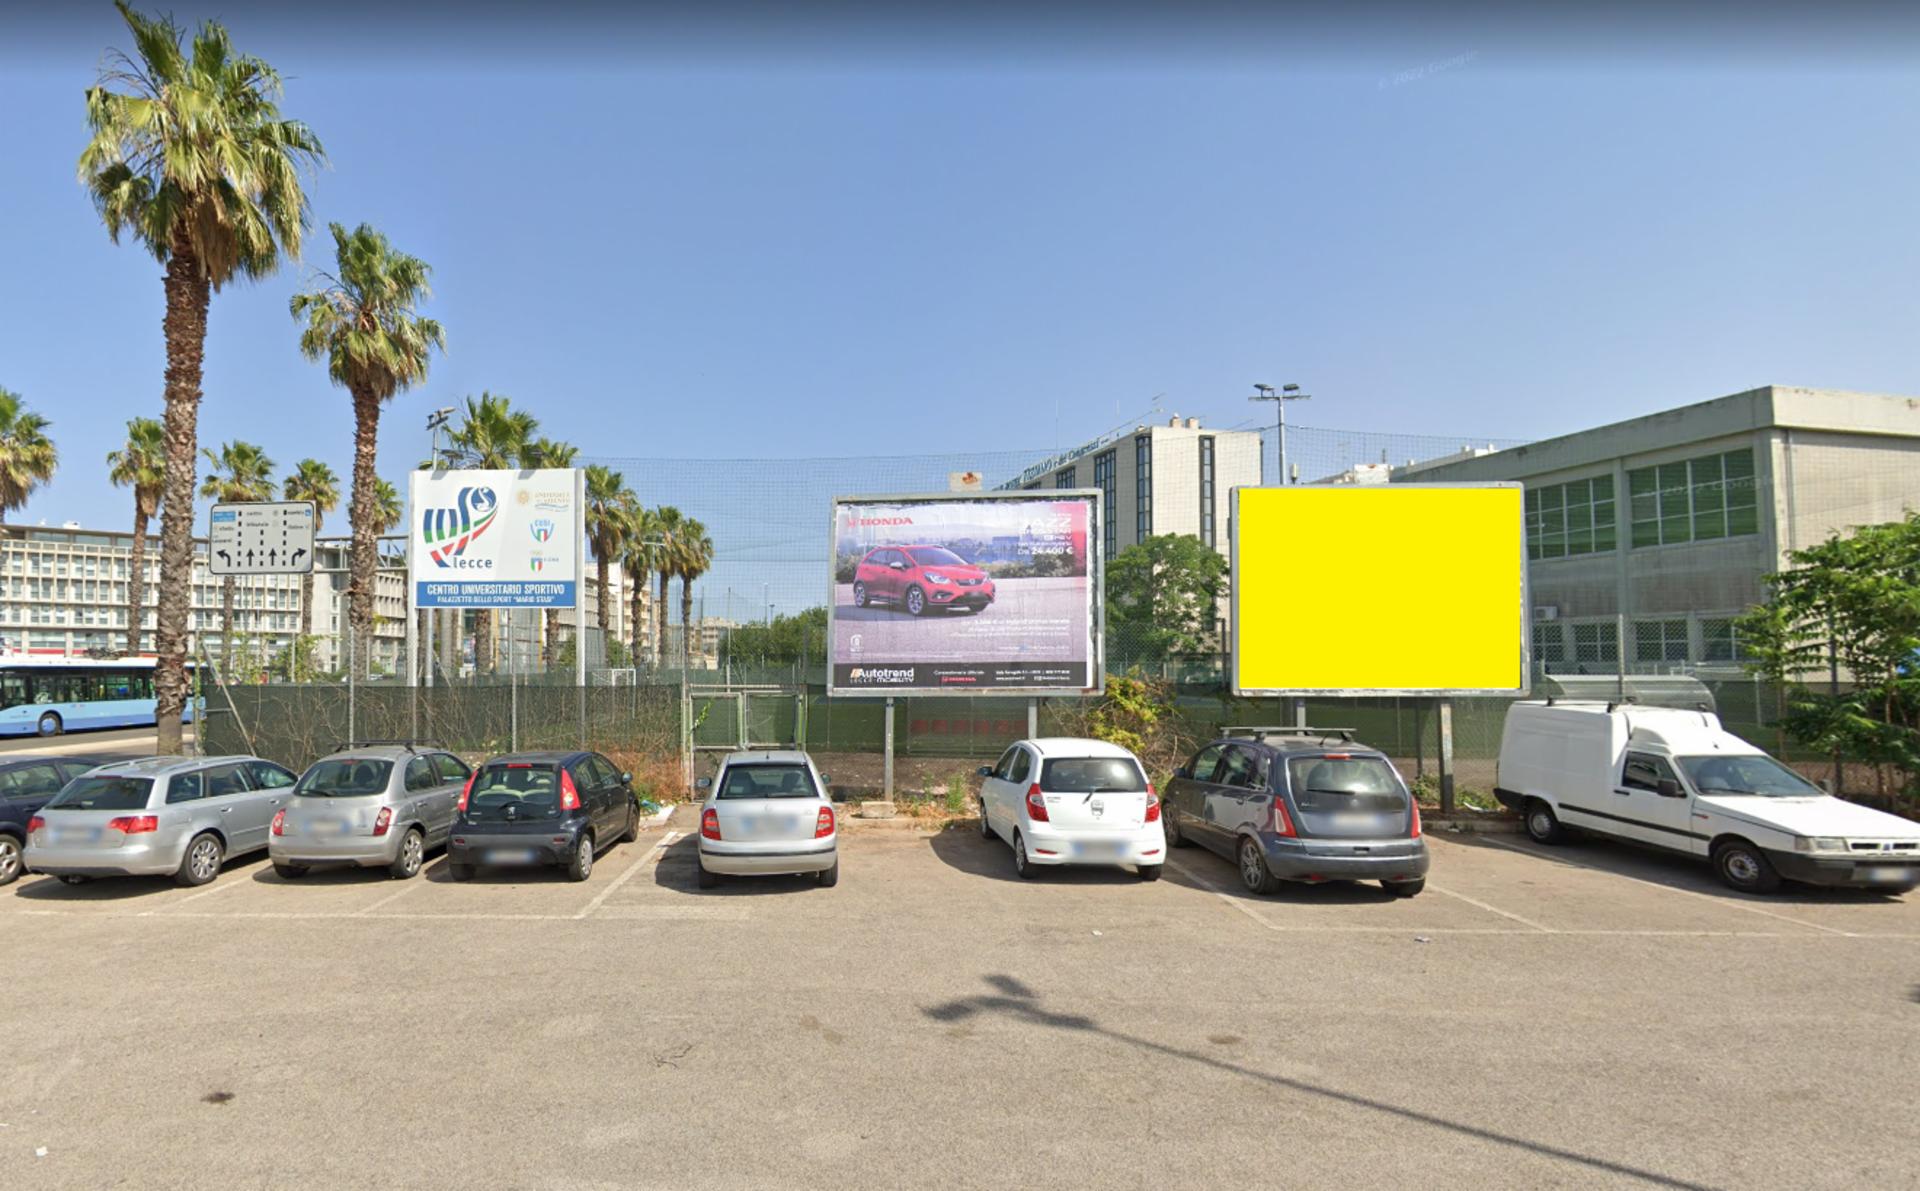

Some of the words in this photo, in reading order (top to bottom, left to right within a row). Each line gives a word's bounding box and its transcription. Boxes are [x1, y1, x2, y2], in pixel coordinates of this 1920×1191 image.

[860, 517, 913, 526] HONDA
[453, 557, 493, 568] lecce
[427, 584, 459, 595] CENTRO
[461, 584, 521, 595] UNIVERSITARIO
[524, 584, 565, 595] SPORTIVO
[852, 667, 914, 678] Autotrend
